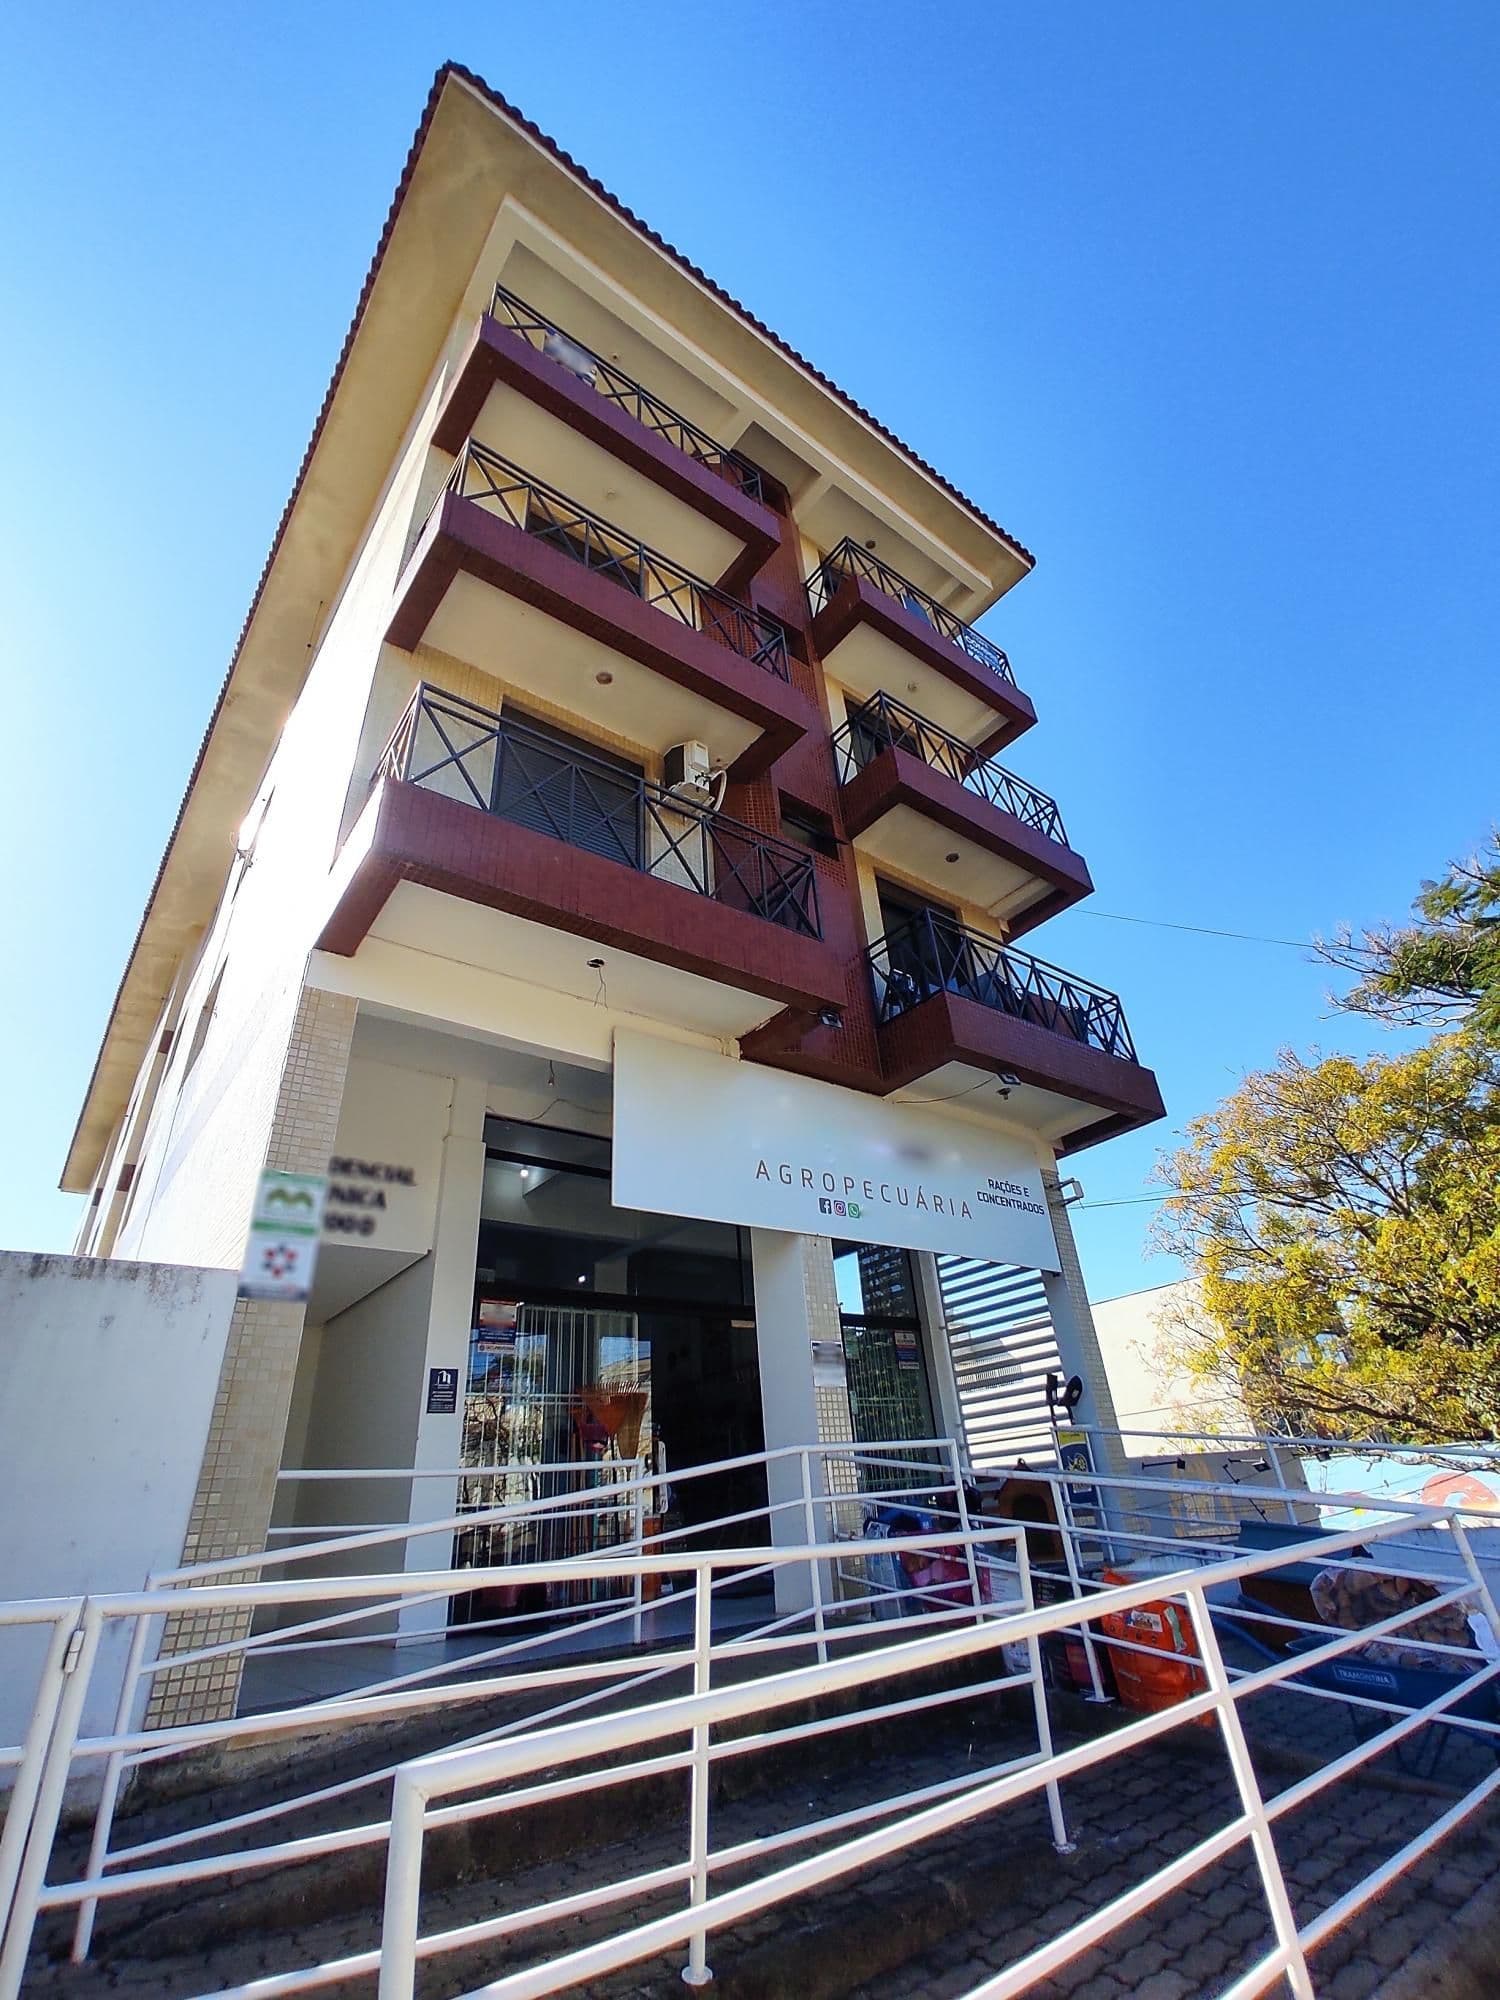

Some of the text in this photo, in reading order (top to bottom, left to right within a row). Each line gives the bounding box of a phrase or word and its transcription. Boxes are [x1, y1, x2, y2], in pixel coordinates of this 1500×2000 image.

[755, 1159, 973, 1219] AGROPECUÁRIA
[987, 1178, 1030, 1197] RAÇÕES E
[976, 1191, 1045, 1215] CONCENTRADOS
